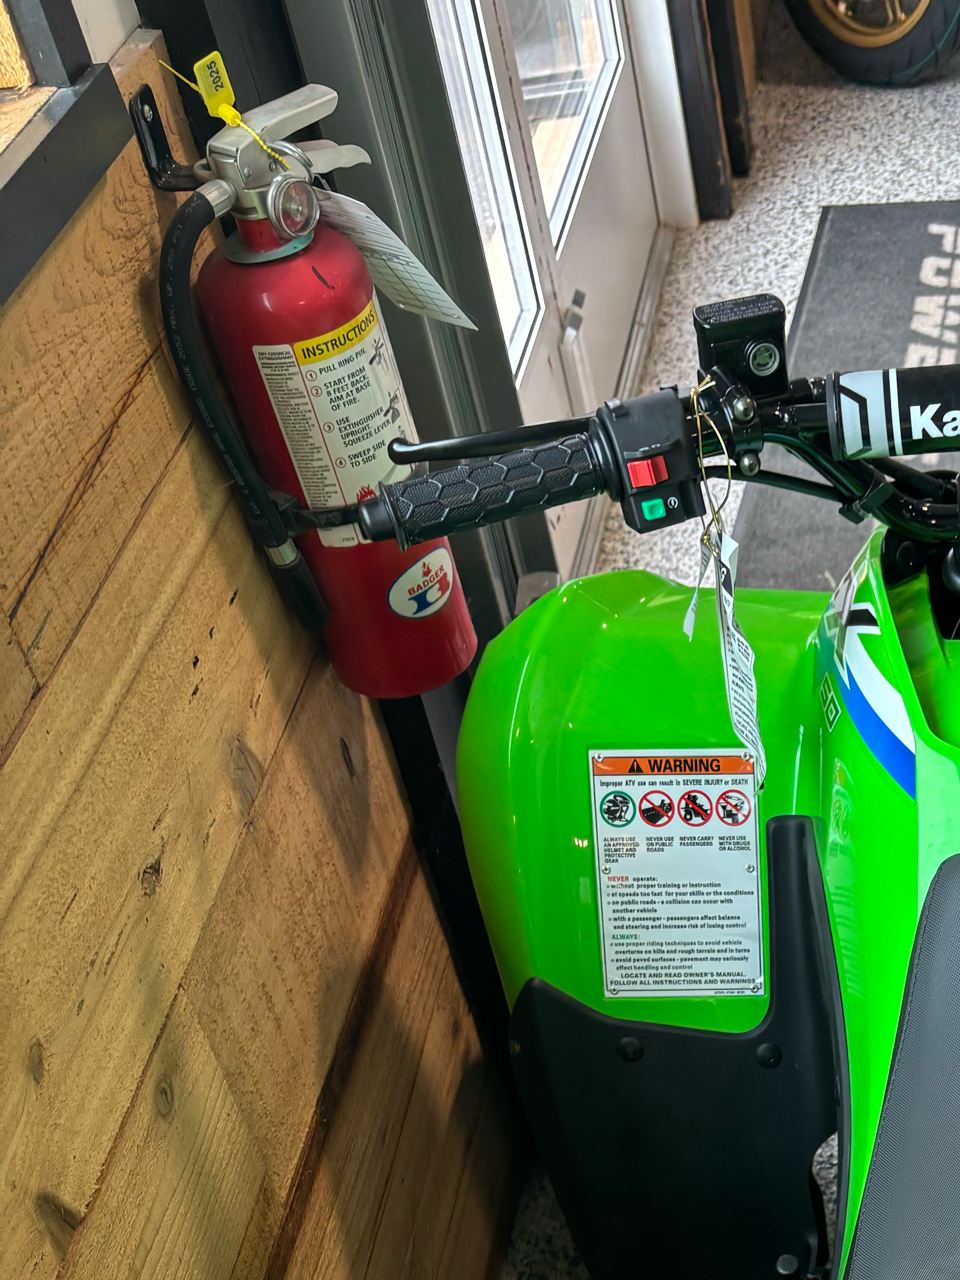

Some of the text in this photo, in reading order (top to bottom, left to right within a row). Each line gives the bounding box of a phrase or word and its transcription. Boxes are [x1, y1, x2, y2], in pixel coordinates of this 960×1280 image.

[206, 60, 224, 92] 2025
[302, 309, 375, 359] INSTRUCTIONS
[318, 364, 337, 374] PULL
[337, 354, 354, 367] RING
[324, 377, 345, 390] START
[347, 366, 365, 380] FROM
[333, 384, 349, 395] FEET
[329, 380, 370, 404] AIM AT BASE
[331, 398, 359, 411] OF FIRE.
[336, 416, 350, 426] USE
[339, 407, 383, 433] EXTINGUISHER
[343, 419, 390, 447] SQUEEZE LEVER
[348, 449, 371, 461] SWEEP
[372, 439, 385, 451] SIDE
[361, 453, 377, 464] SIDE
[408, 564, 445, 596] BADGER
[647, 758, 721, 772] WARNING
